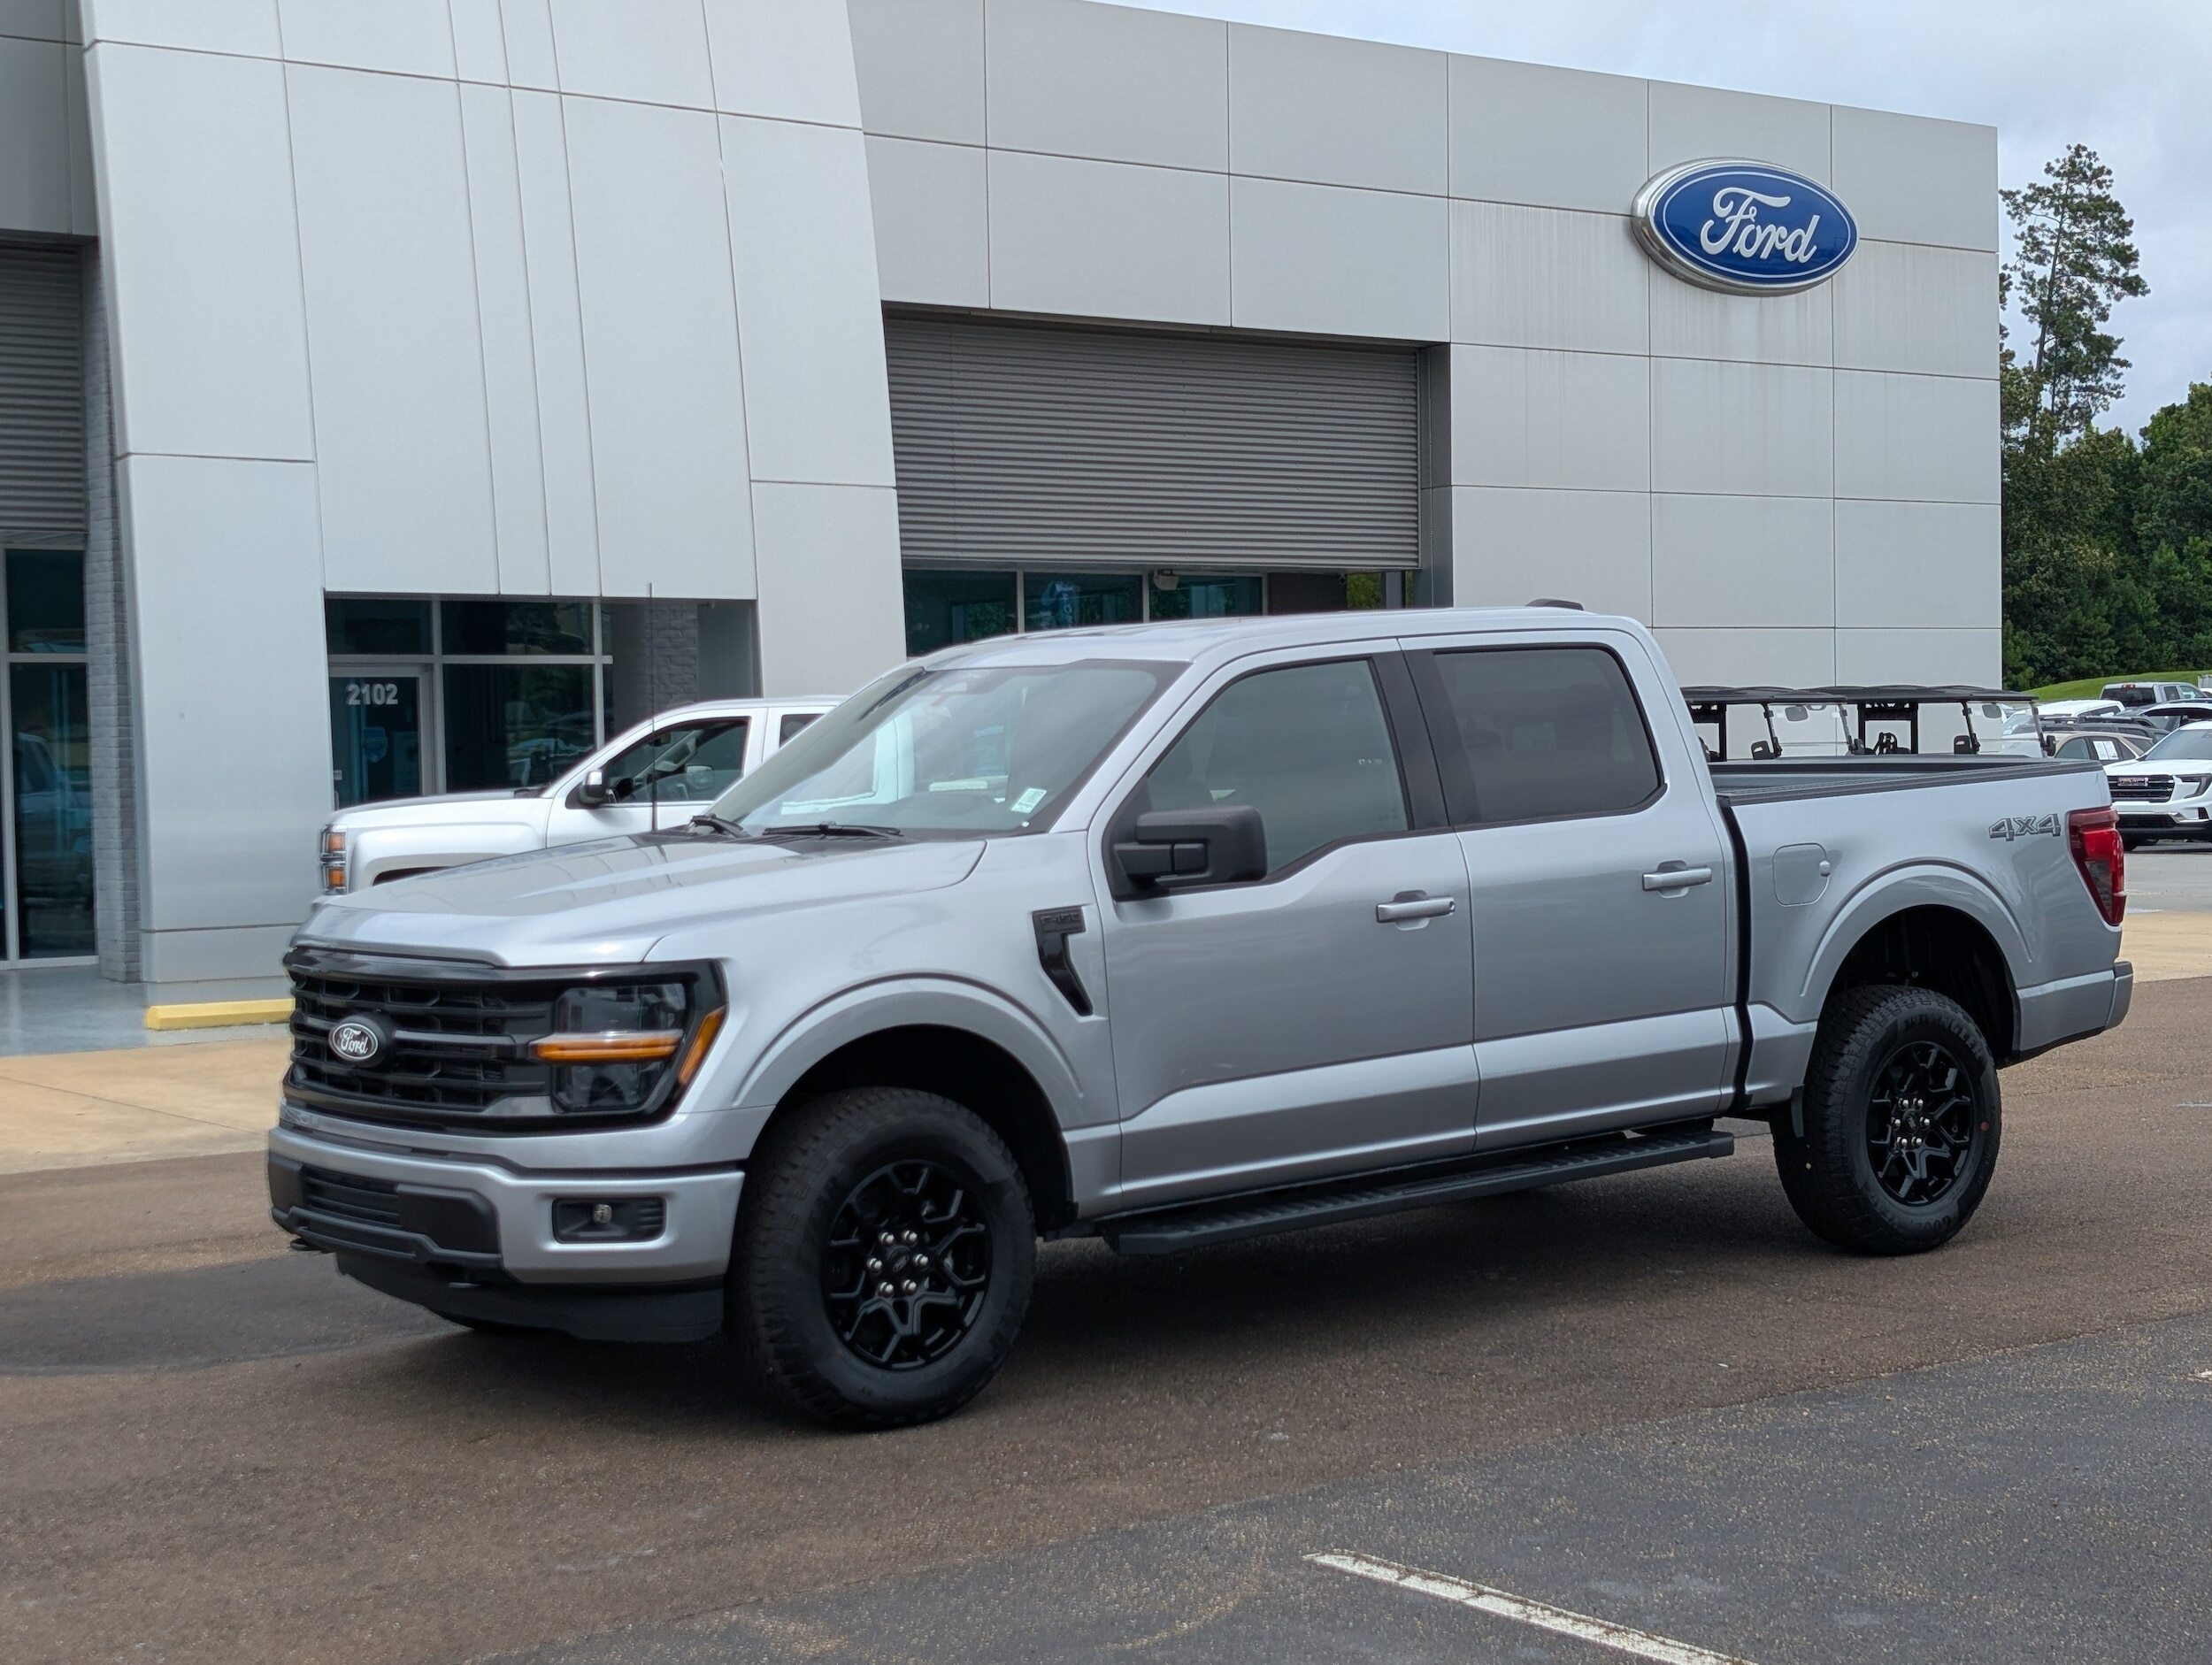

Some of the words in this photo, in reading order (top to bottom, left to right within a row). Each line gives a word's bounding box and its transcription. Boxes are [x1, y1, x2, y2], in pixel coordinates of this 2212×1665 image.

[1700, 187, 1820, 264] Ford
[347, 683, 399, 706] 2102
[341, 1027, 369, 1054] Ford
